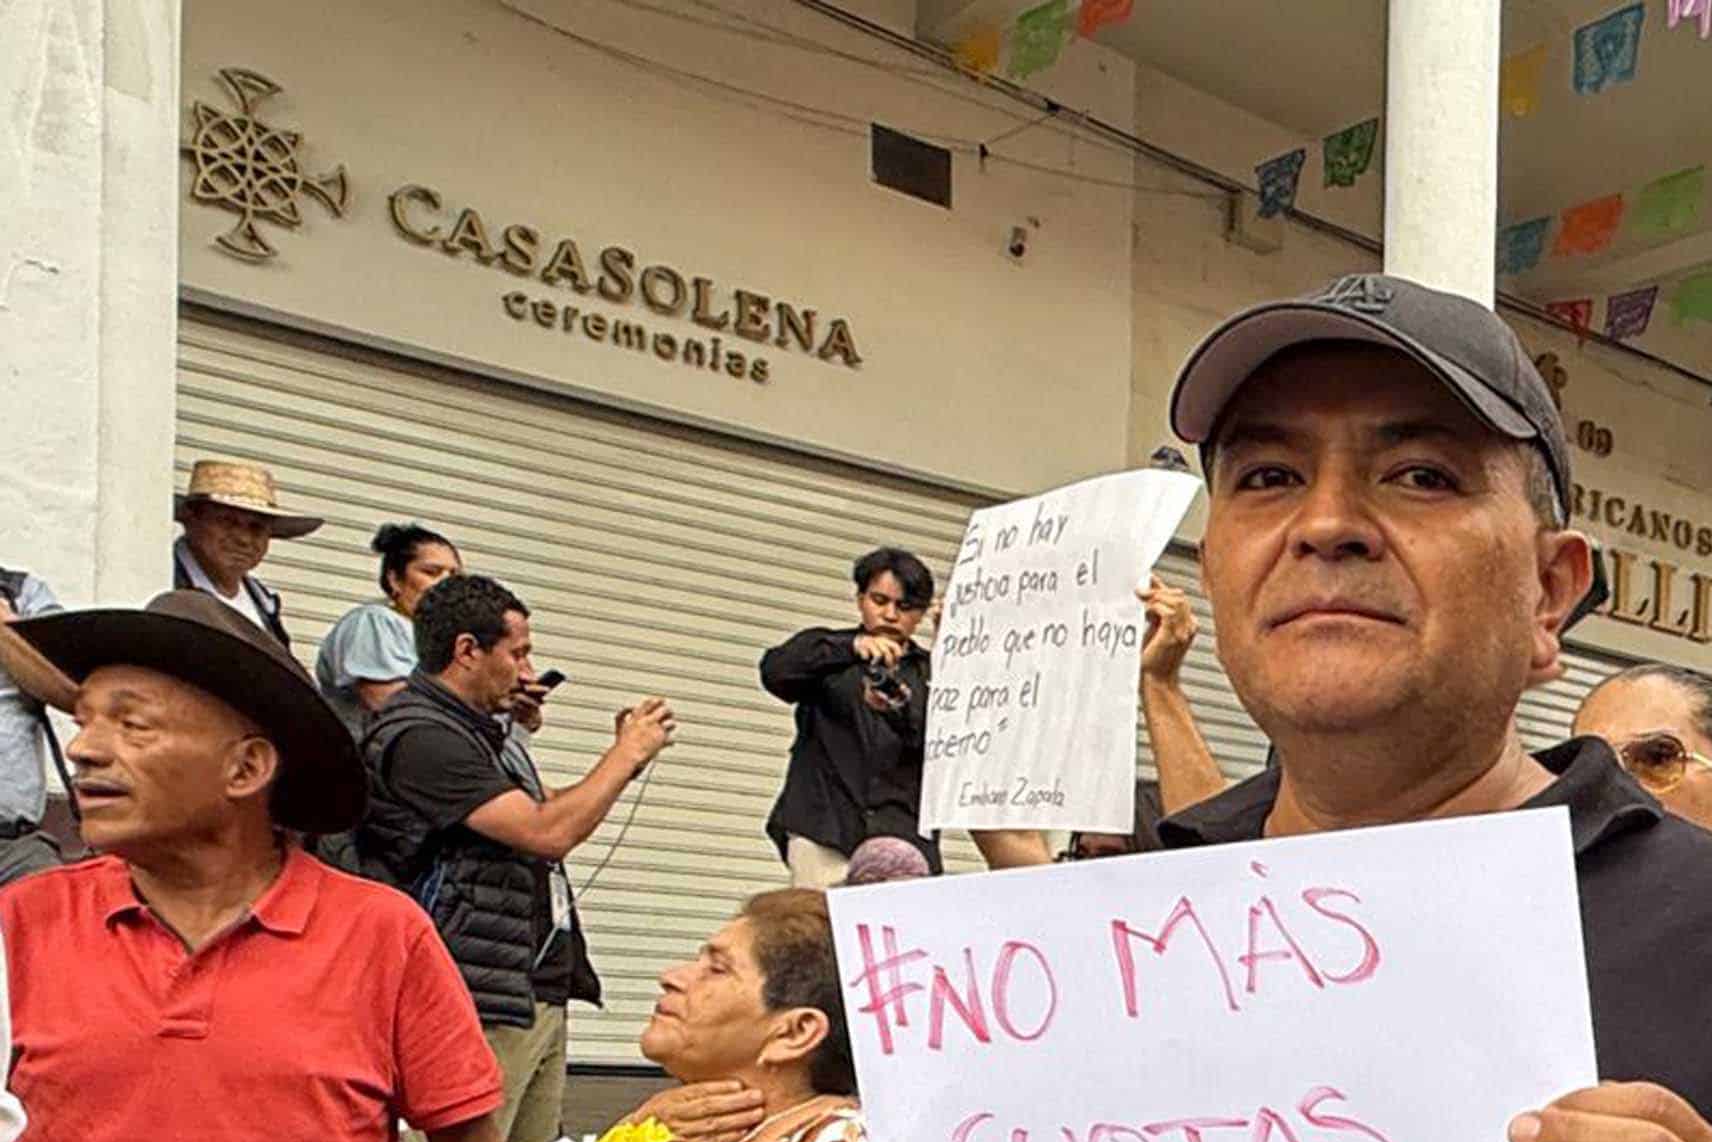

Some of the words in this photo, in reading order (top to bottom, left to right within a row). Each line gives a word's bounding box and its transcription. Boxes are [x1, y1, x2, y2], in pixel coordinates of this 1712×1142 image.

[387, 185, 863, 368] CASASOLENA
[501, 290, 771, 384] ceremonias
[995, 525, 1019, 552] no
[1028, 501, 1071, 545] hay
[1016, 570, 1058, 606] para
[1076, 548, 1099, 587] el
[1003, 628, 1036, 669] que
[1042, 623, 1069, 648] no
[966, 685, 1009, 723] para
[1019, 672, 1041, 708] el
[850, 922, 1058, 1056] #NO
